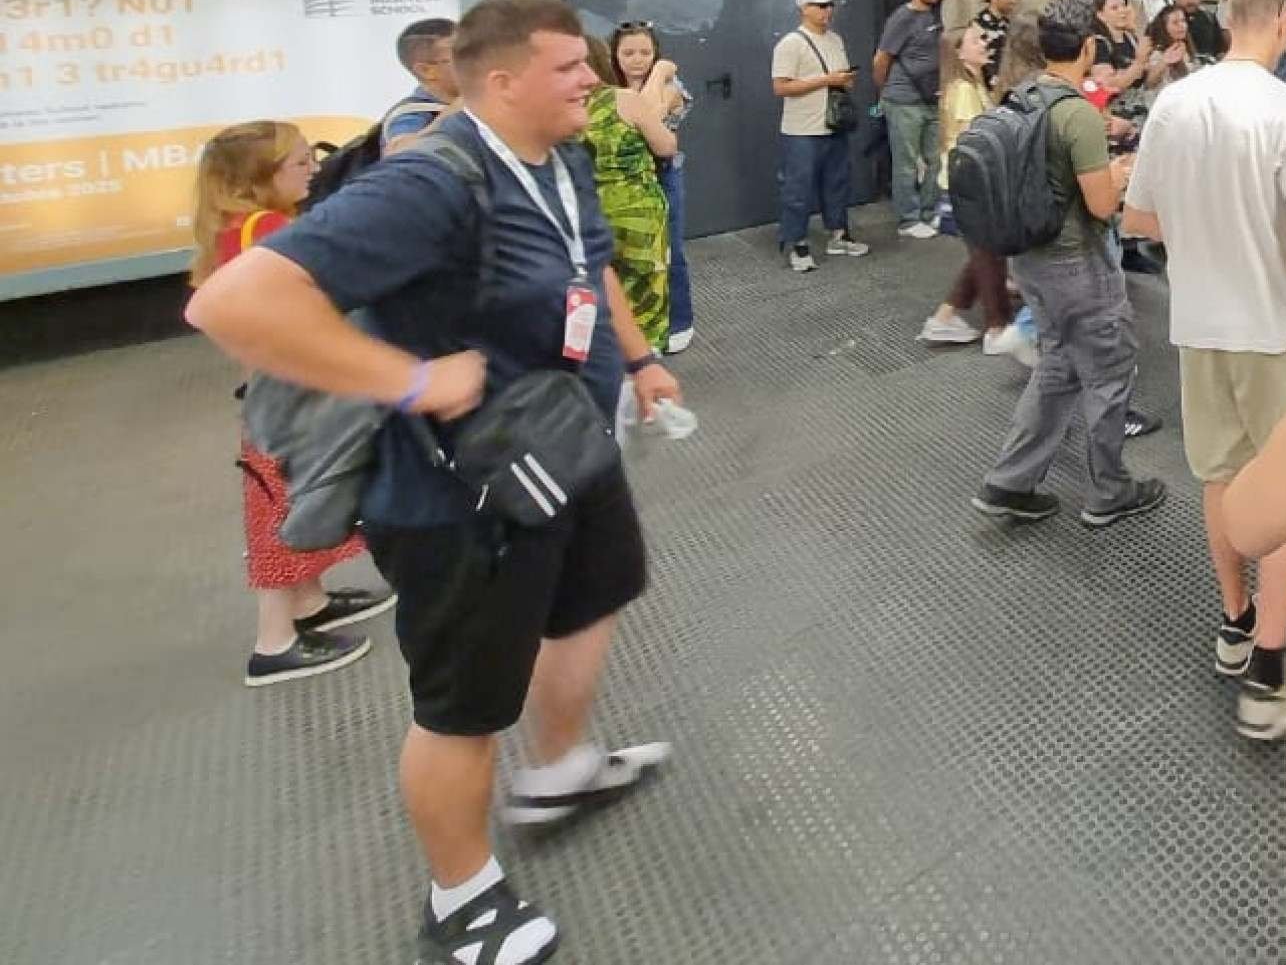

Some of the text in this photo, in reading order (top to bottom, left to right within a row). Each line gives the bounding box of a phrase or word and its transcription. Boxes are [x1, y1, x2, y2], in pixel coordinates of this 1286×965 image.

[130, 24, 175, 48] d1
[56, 61, 80, 86] 3
[96, 46, 287, 84] tr4gu4rd1
